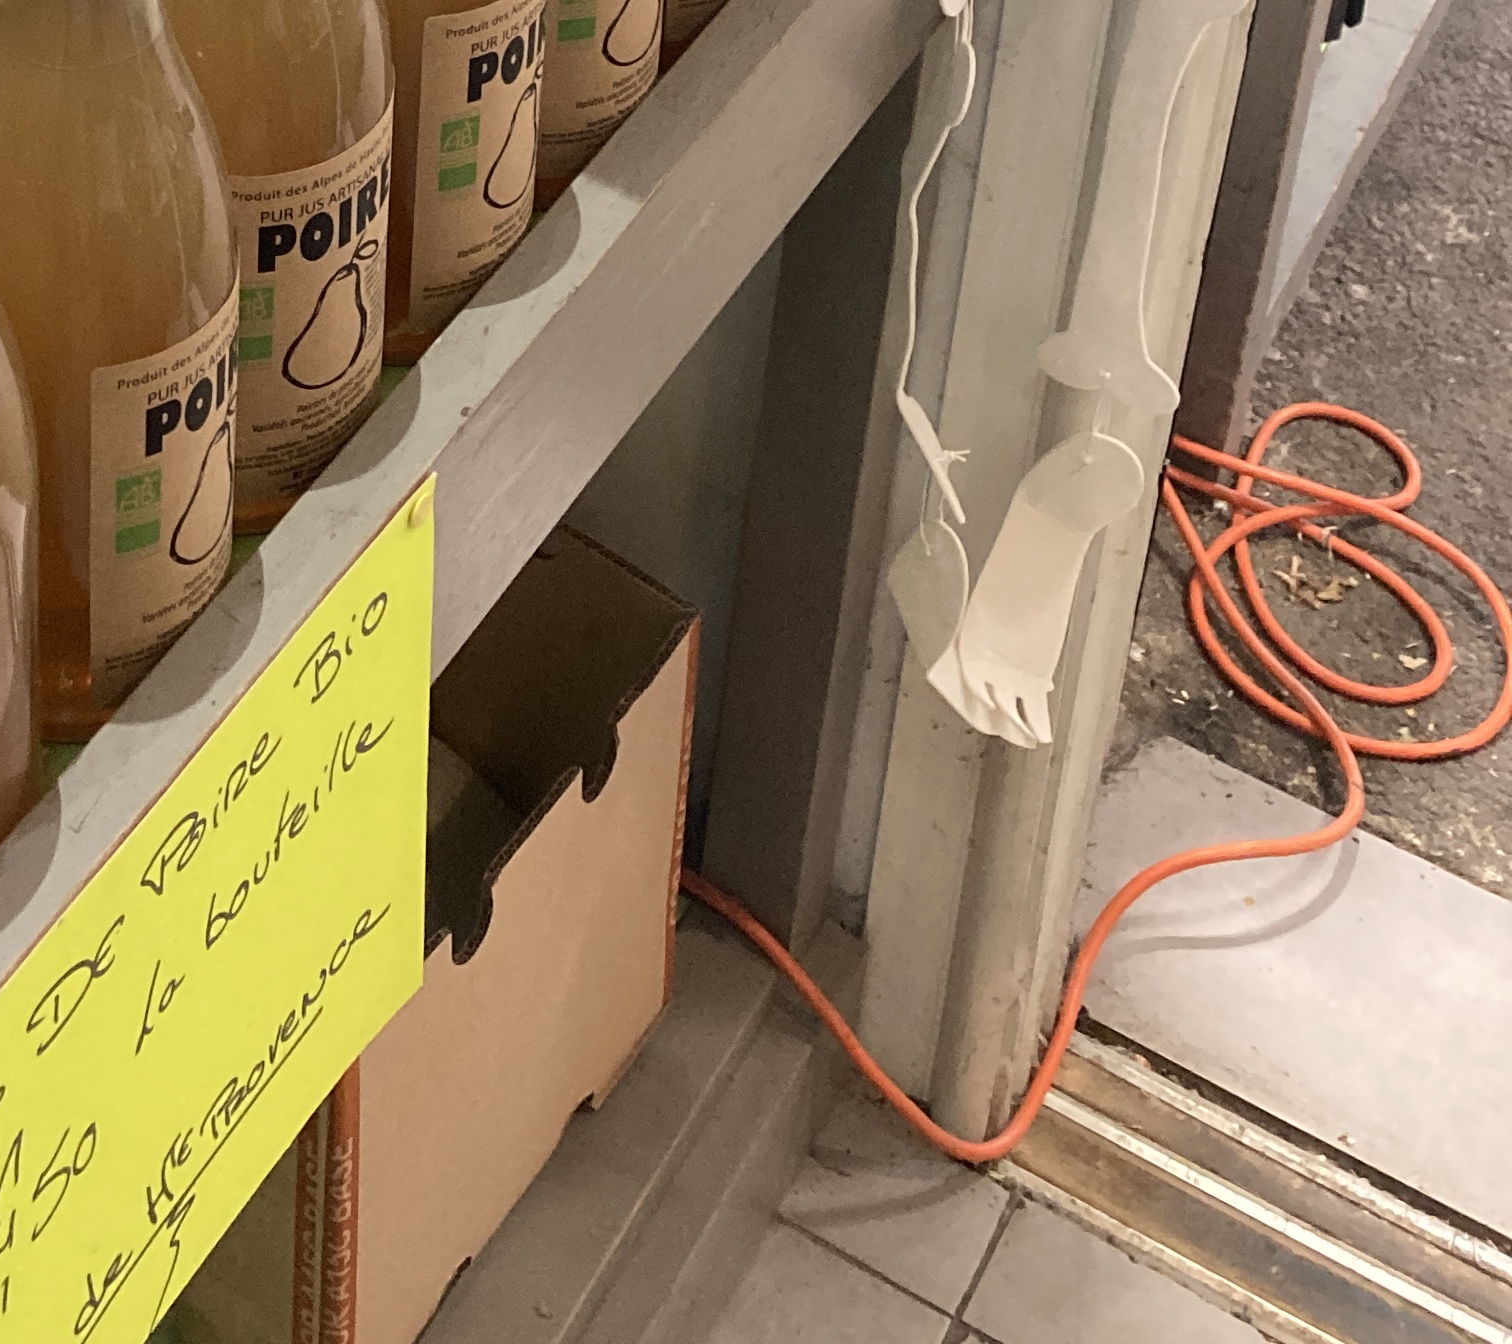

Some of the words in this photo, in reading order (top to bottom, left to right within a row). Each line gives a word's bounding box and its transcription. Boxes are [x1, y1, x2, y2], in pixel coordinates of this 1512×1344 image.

[445, 20, 491, 41] Produit
[490, 10, 510, 30] des
[470, 36, 498, 55] PUR
[499, 23, 520, 44] JUS
[231, 188, 282, 203] Produit
[285, 183, 308, 198] des
[311, 169, 343, 191] Alpes
[260, 207, 294, 224] PUR
[298, 197, 325, 218] JUS
[116, 365, 169, 391] Produit
[171, 355, 192, 373] des
[147, 381, 180, 407] PUR
[182, 365, 207, 391] JUS
[206, 716, 396, 950] bouteille
[74, 1249, 134, 1336] de
